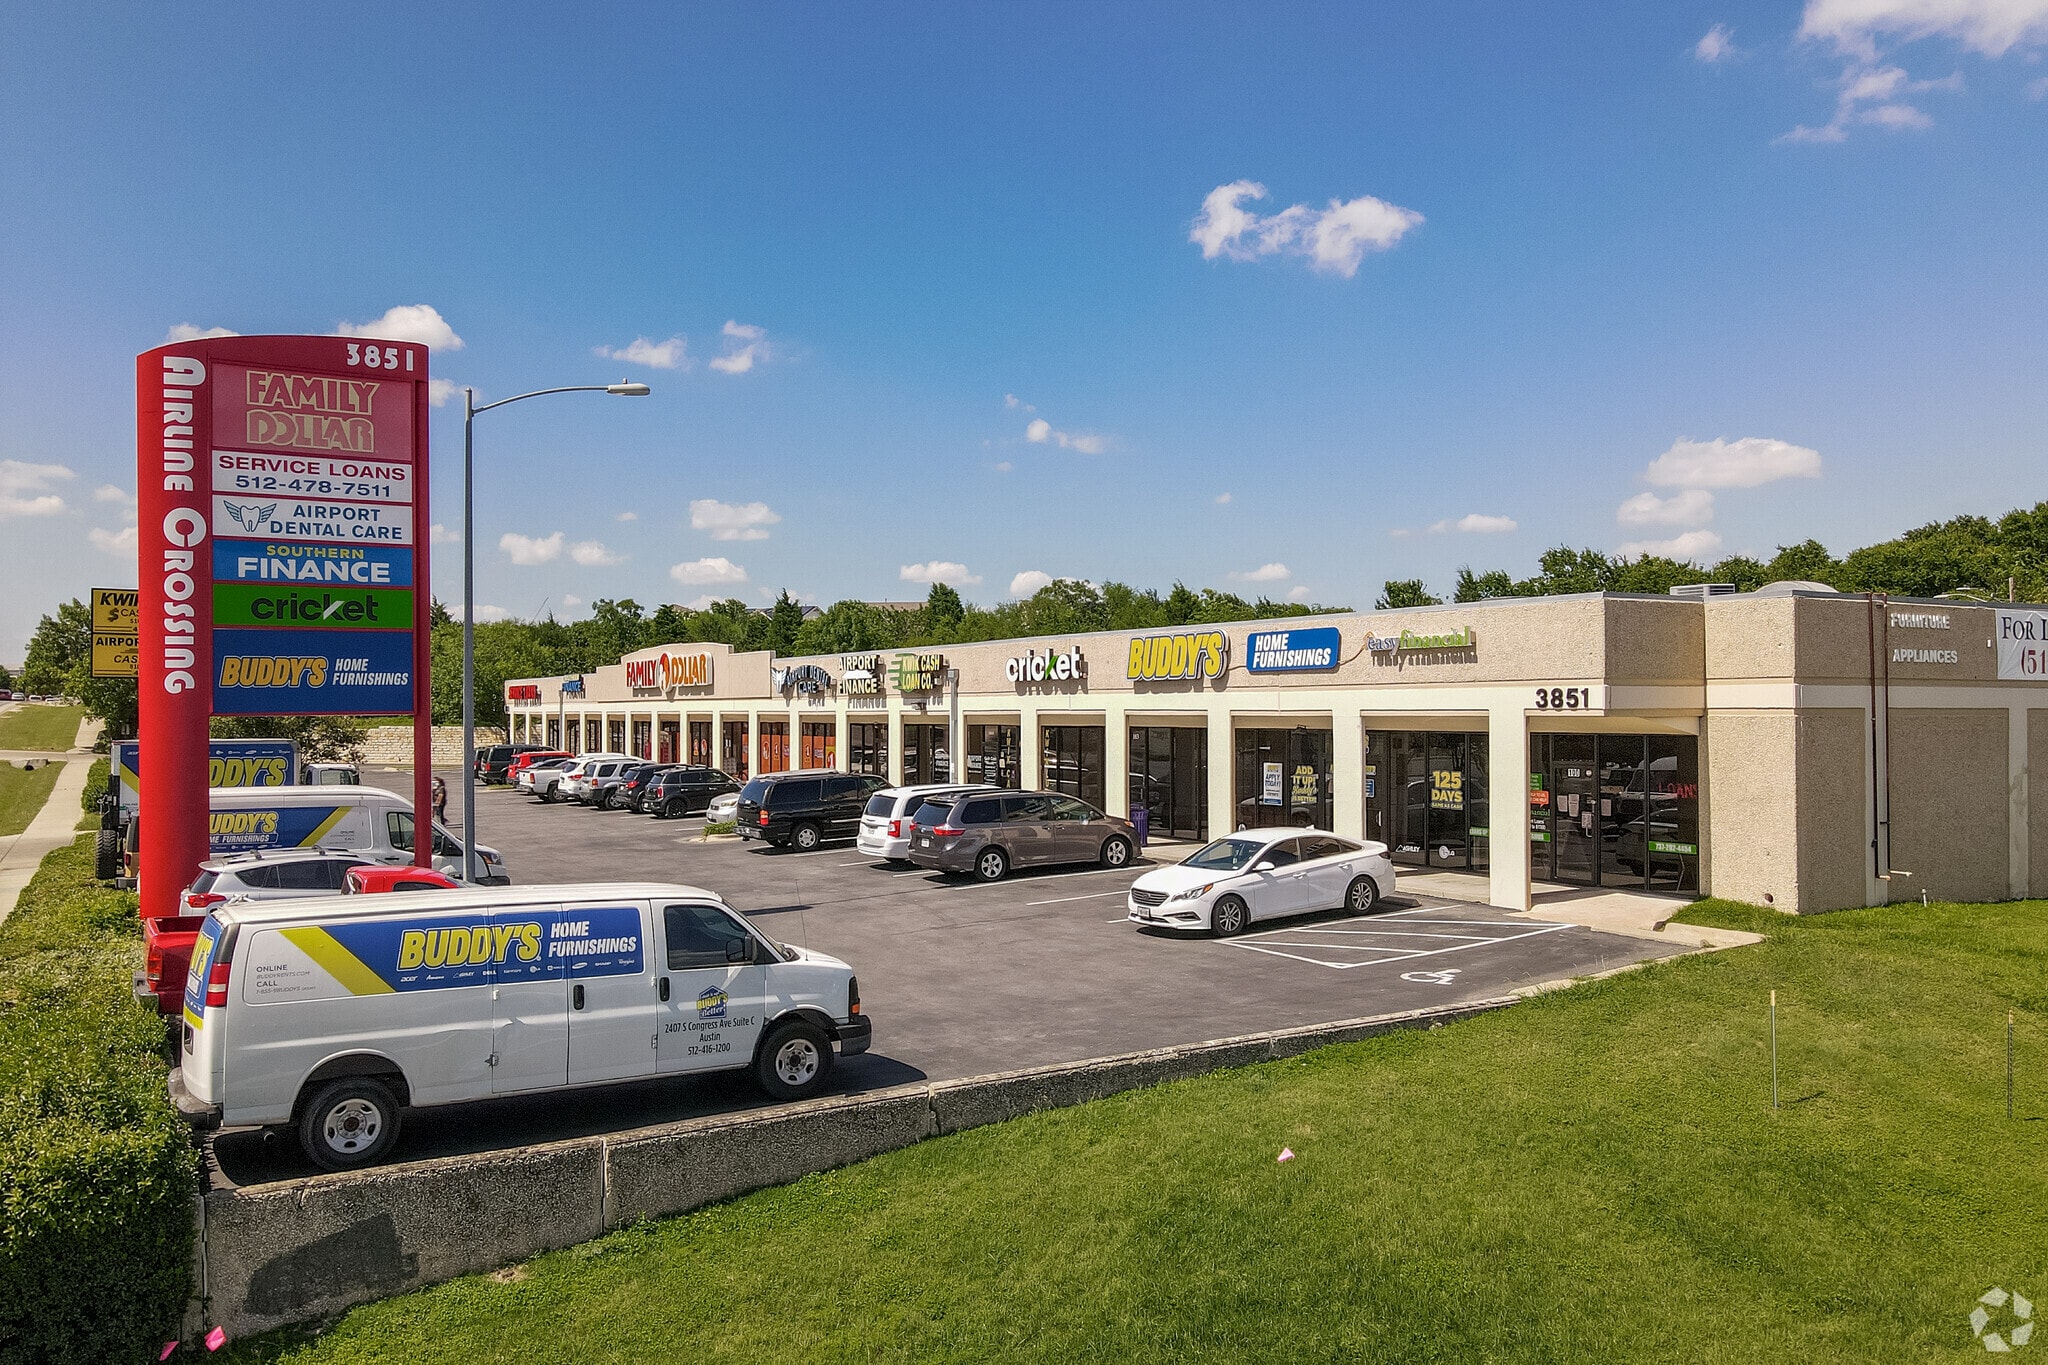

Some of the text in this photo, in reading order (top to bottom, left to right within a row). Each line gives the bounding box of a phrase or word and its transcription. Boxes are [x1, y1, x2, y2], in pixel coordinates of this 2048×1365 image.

[346, 344, 414, 371] 3851
[246, 370, 380, 415] FAMILY
[246, 409, 375, 453] DOLLAR
[218, 455, 406, 481] SERVICE LOANS
[235, 475, 391, 497] 512-478-7511
[292, 505, 381, 521] AIRPORT
[163, 356, 207, 694] AIRLINE CROSSING
[270, 521, 402, 539] DENTAL CARE
[266, 545, 364, 559] SOUTHERN
[237, 556, 390, 583] FINANCE
[100, 592, 139, 606] KWI
[250, 593, 379, 622] cricket
[1890, 613, 1950, 630] FURNITURE
[2001, 616, 2037, 640] FOR
[1255, 634, 1289, 651] HOME
[838, 655, 877, 670] AIRPORT
[920, 655, 940, 671] CASH
[1005, 645, 1081, 682] cricket
[1127, 630, 1227, 681] BUDDY'S
[1253, 648, 1331, 668] FURNISHINGS
[1892, 649, 1958, 664] APPLIANCES
[219, 656, 329, 689] BUDDY'S
[335, 658, 368, 672] HOME
[627, 654, 707, 687] FAMILY DOLLAR
[332, 671, 408, 686] FURNISHINGS
[799, 680, 818, 693] CARE
[838, 679, 877, 694] FINANCE
[902, 673, 934, 690] LOAN CO.
[1535, 688, 1589, 708] 3851
[1295, 765, 1314, 775] ADD
[1293, 776, 1316, 784] IT UP!
[1432, 771, 1462, 789] 125
[1431, 789, 1464, 802] DAYS
[222, 835, 270, 843] FURNISHINGS
[550, 921, 589, 938] HOME
[397, 921, 543, 971] BUDDY'S
[548, 936, 637, 957] FURNISHINGS
[256, 964, 288, 972] ONLINE
[696, 993, 728, 1011] BUDDY'S
[665, 1016, 755, 1033] 2407 S Congress Ave Suite C
[699, 1032, 721, 1042] Austin
[688, 1043, 731, 1056] 512-416-1200
